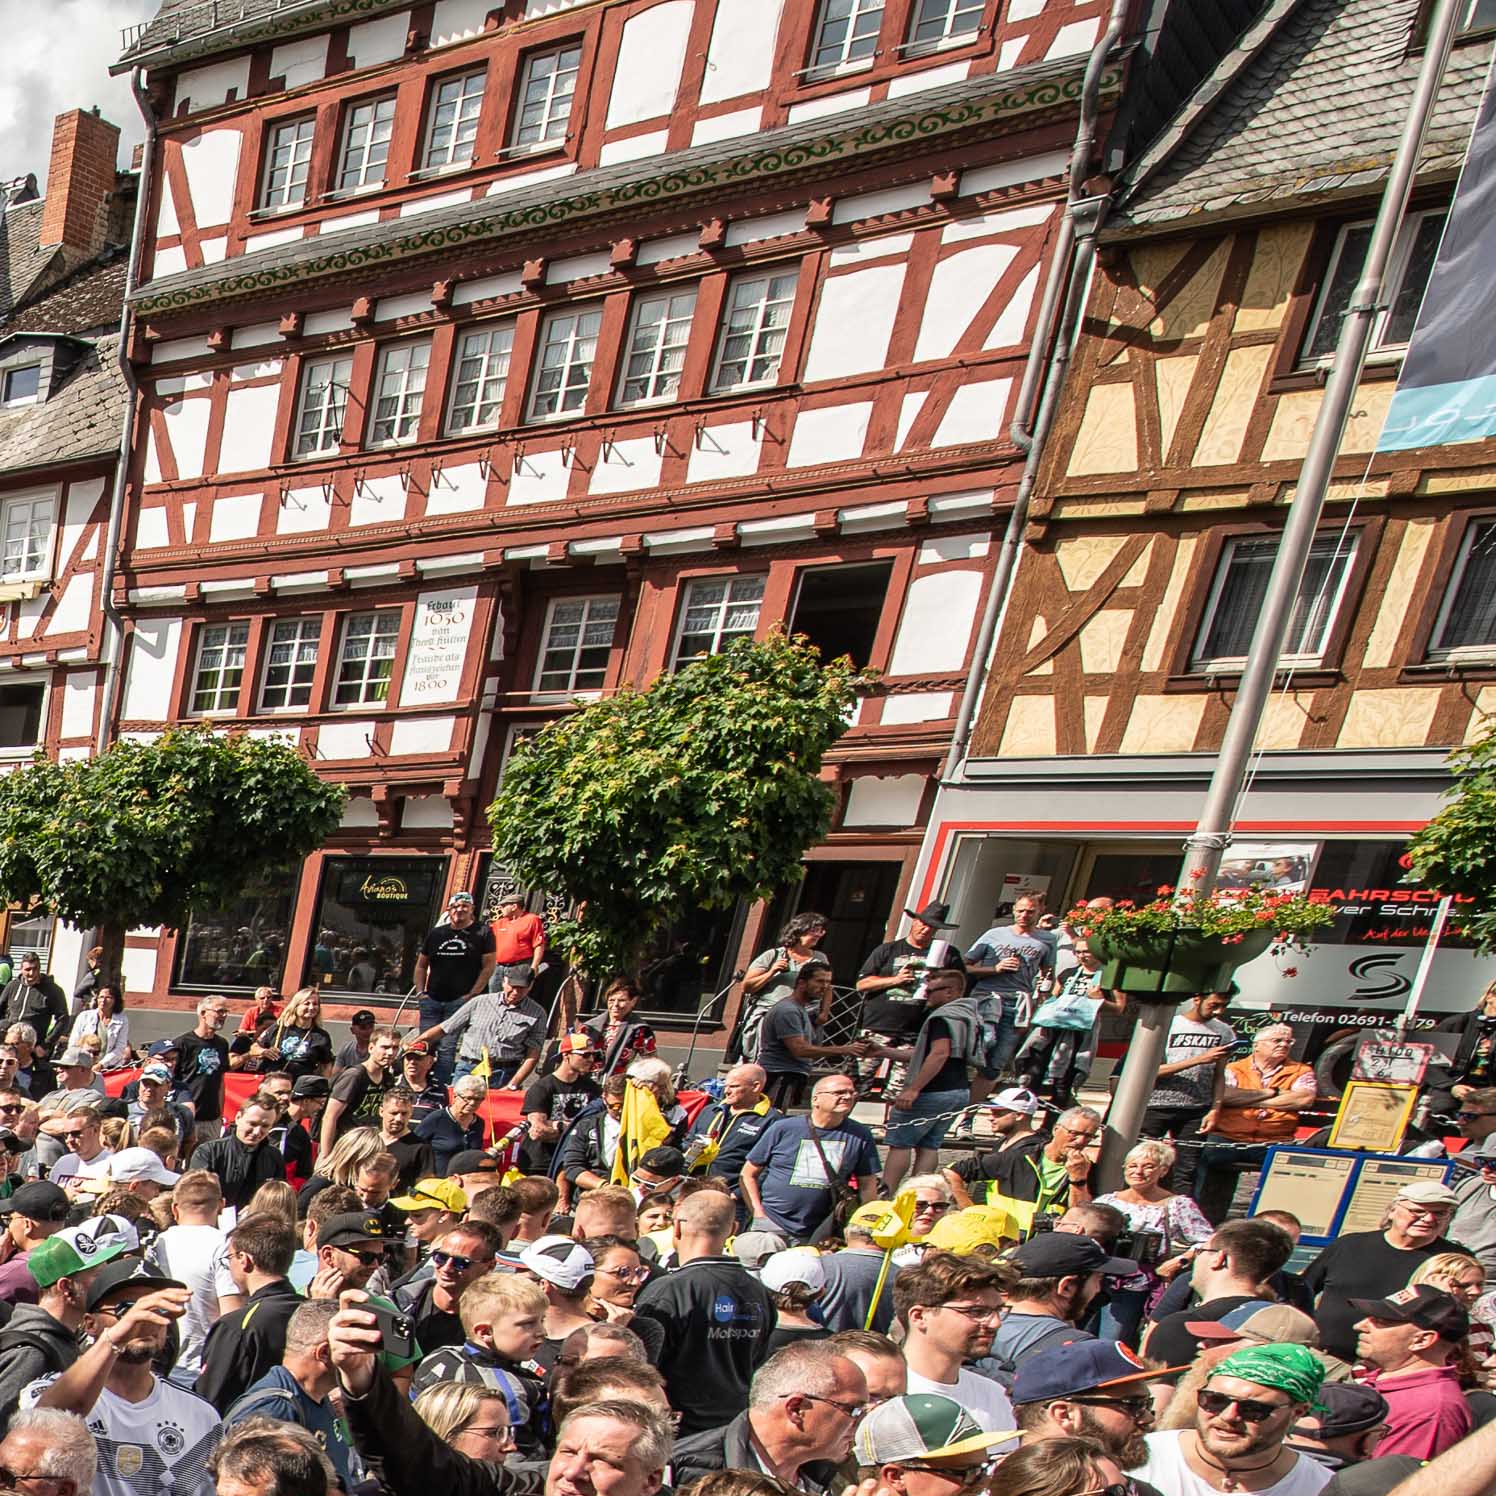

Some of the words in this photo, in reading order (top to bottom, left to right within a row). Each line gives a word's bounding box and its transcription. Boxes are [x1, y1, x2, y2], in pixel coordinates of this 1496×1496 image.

[377, 892, 408, 900] BOUTIQUE
[1281, 1010, 1334, 1025] Telefon
[1172, 1034, 1220, 1048] #SKATE
[715, 1302, 734, 1313] Hair
